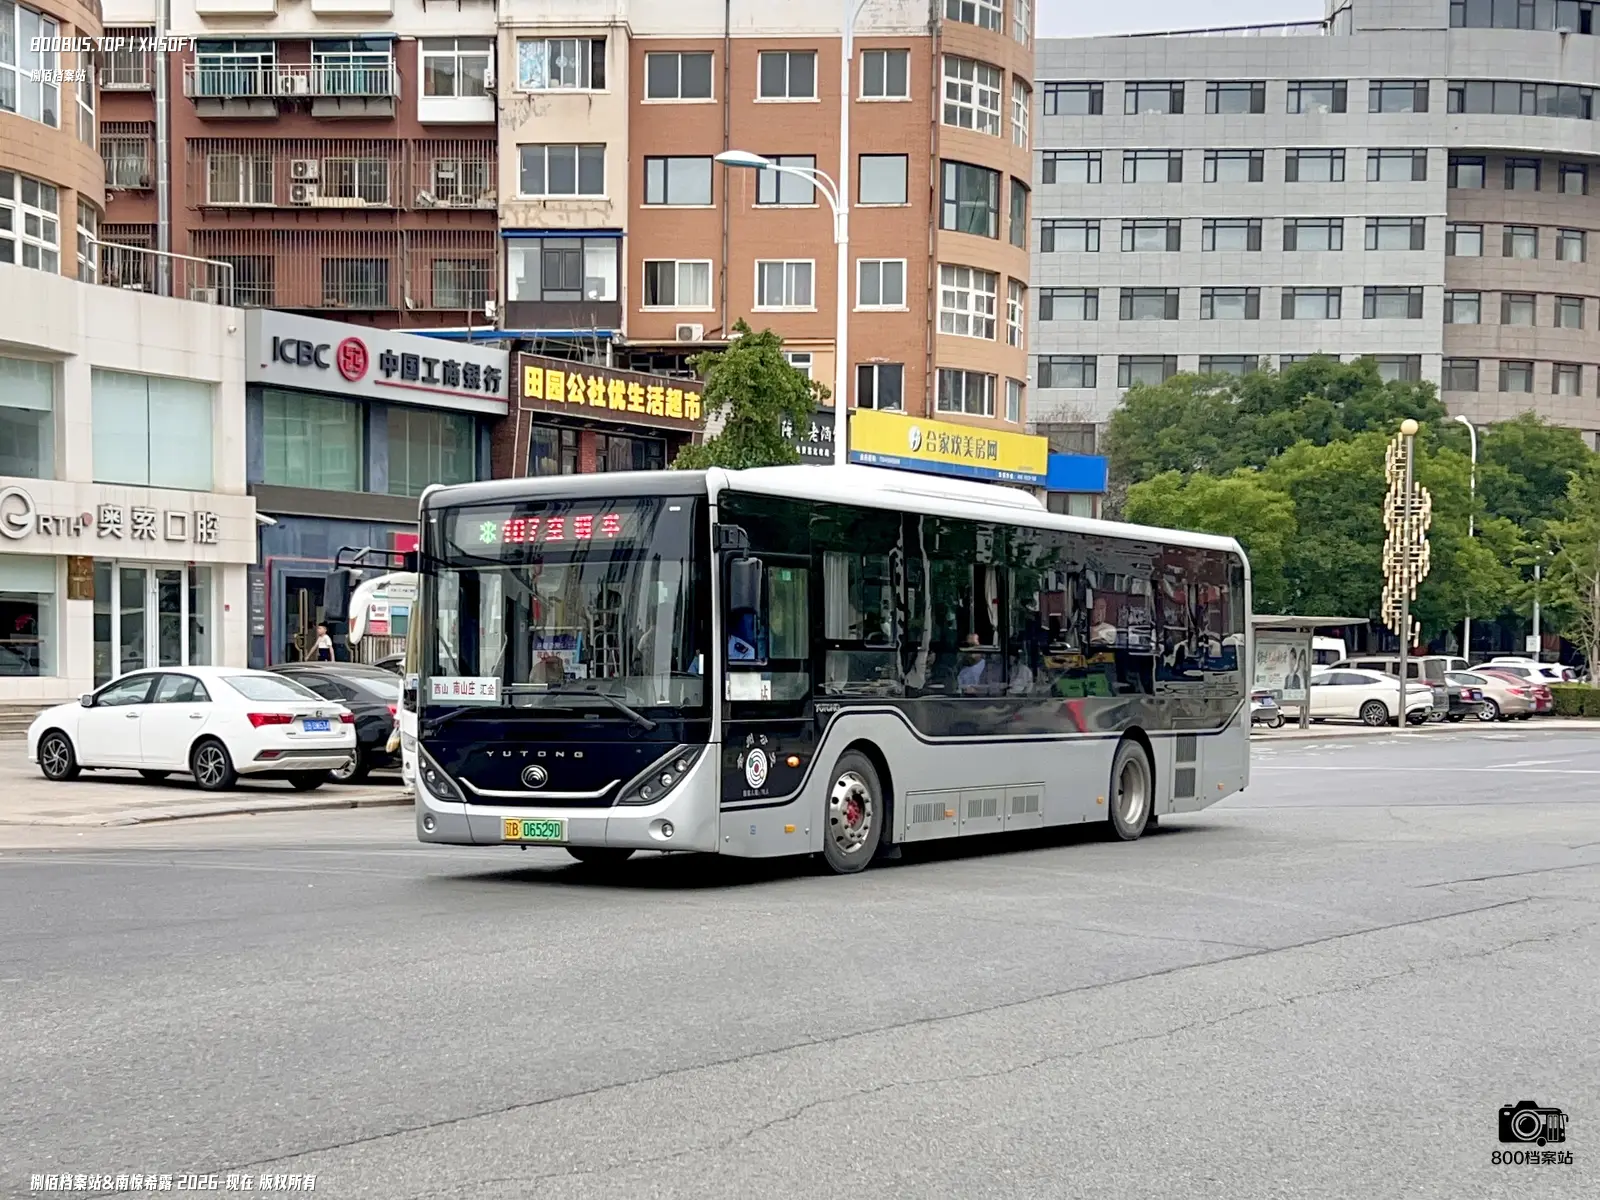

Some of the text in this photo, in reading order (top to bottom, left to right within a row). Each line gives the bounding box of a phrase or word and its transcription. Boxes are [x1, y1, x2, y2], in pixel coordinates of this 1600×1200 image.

[272, 336, 331, 369] ICBC
[379, 349, 502, 393] 中国工商银行
[523, 365, 701, 421] 田园公社优生活超市
[98, 503, 221, 545] 奥索口腔
[486, 750, 584, 758] YUTONG
